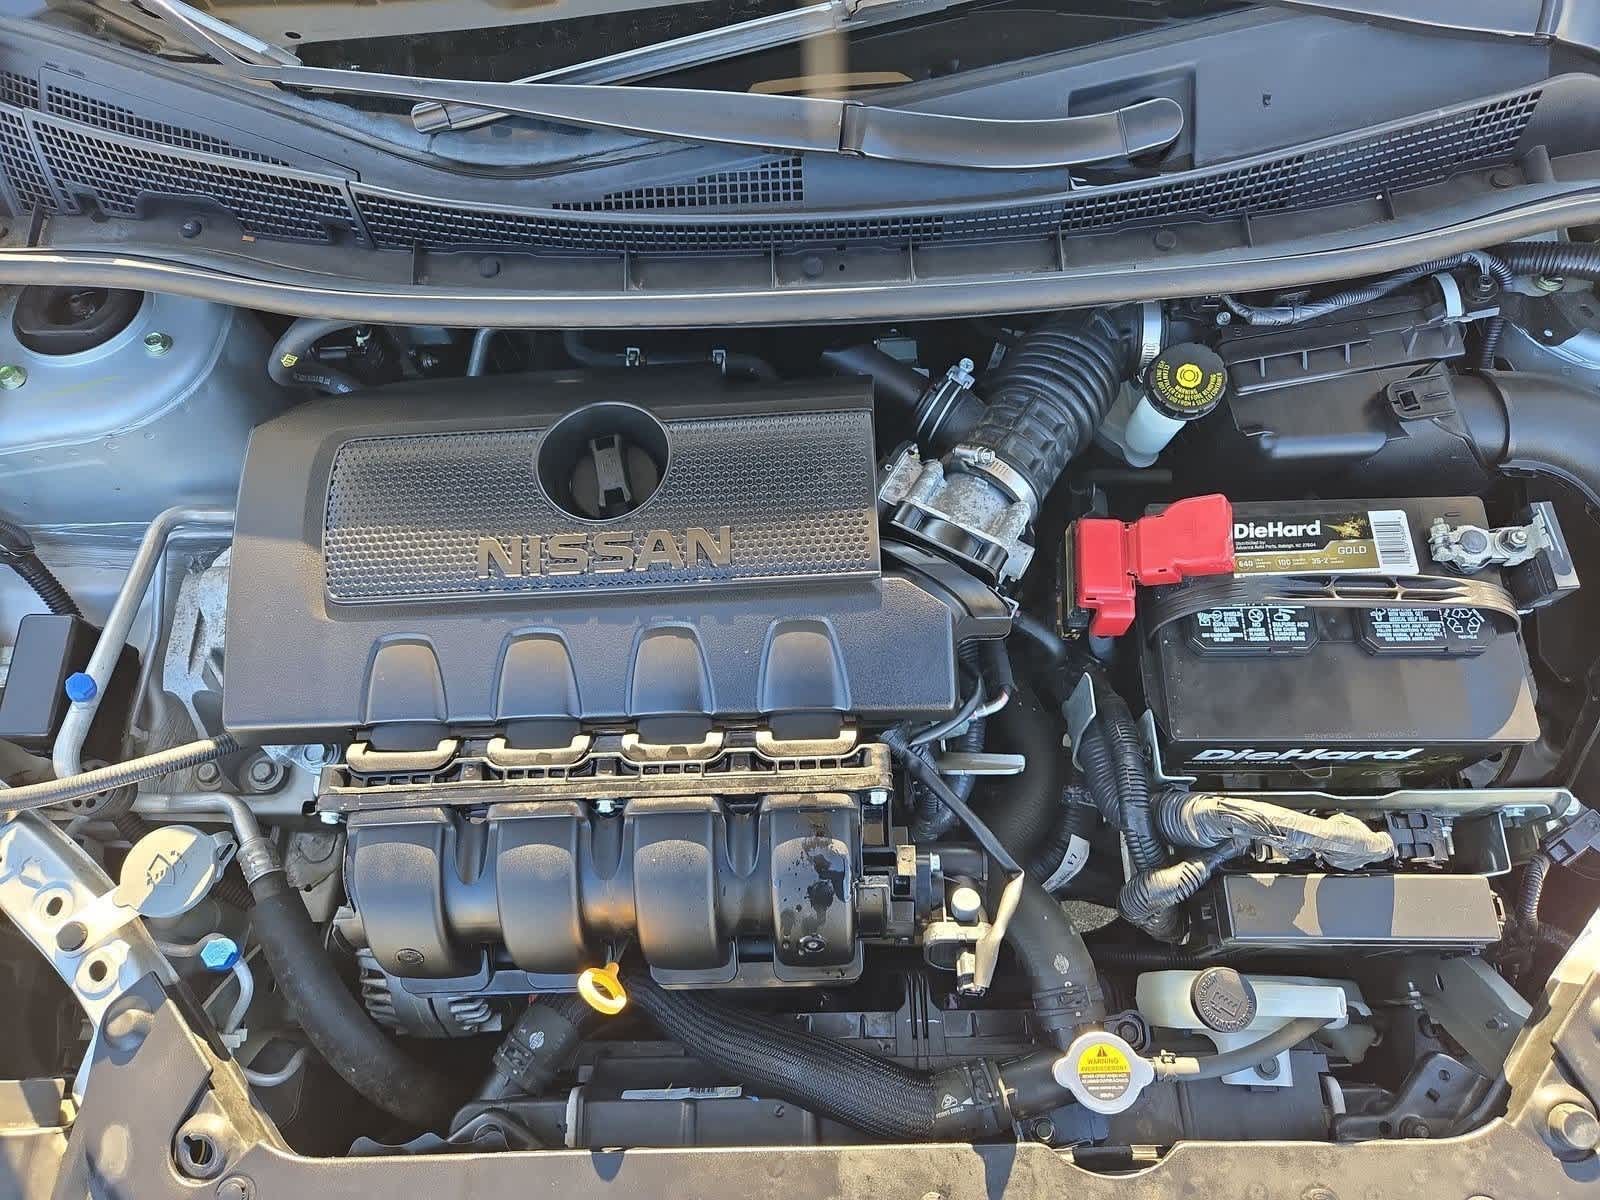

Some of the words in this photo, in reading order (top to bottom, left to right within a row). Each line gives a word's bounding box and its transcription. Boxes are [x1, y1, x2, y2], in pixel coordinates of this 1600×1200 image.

[1234, 520, 1321, 539] DieHard
[478, 526, 732, 579] NISSAN
[1337, 545, 1367, 555] GOLD
[1192, 748, 1425, 760] DieHard
[1088, 1057, 1119, 1065] WARNING
